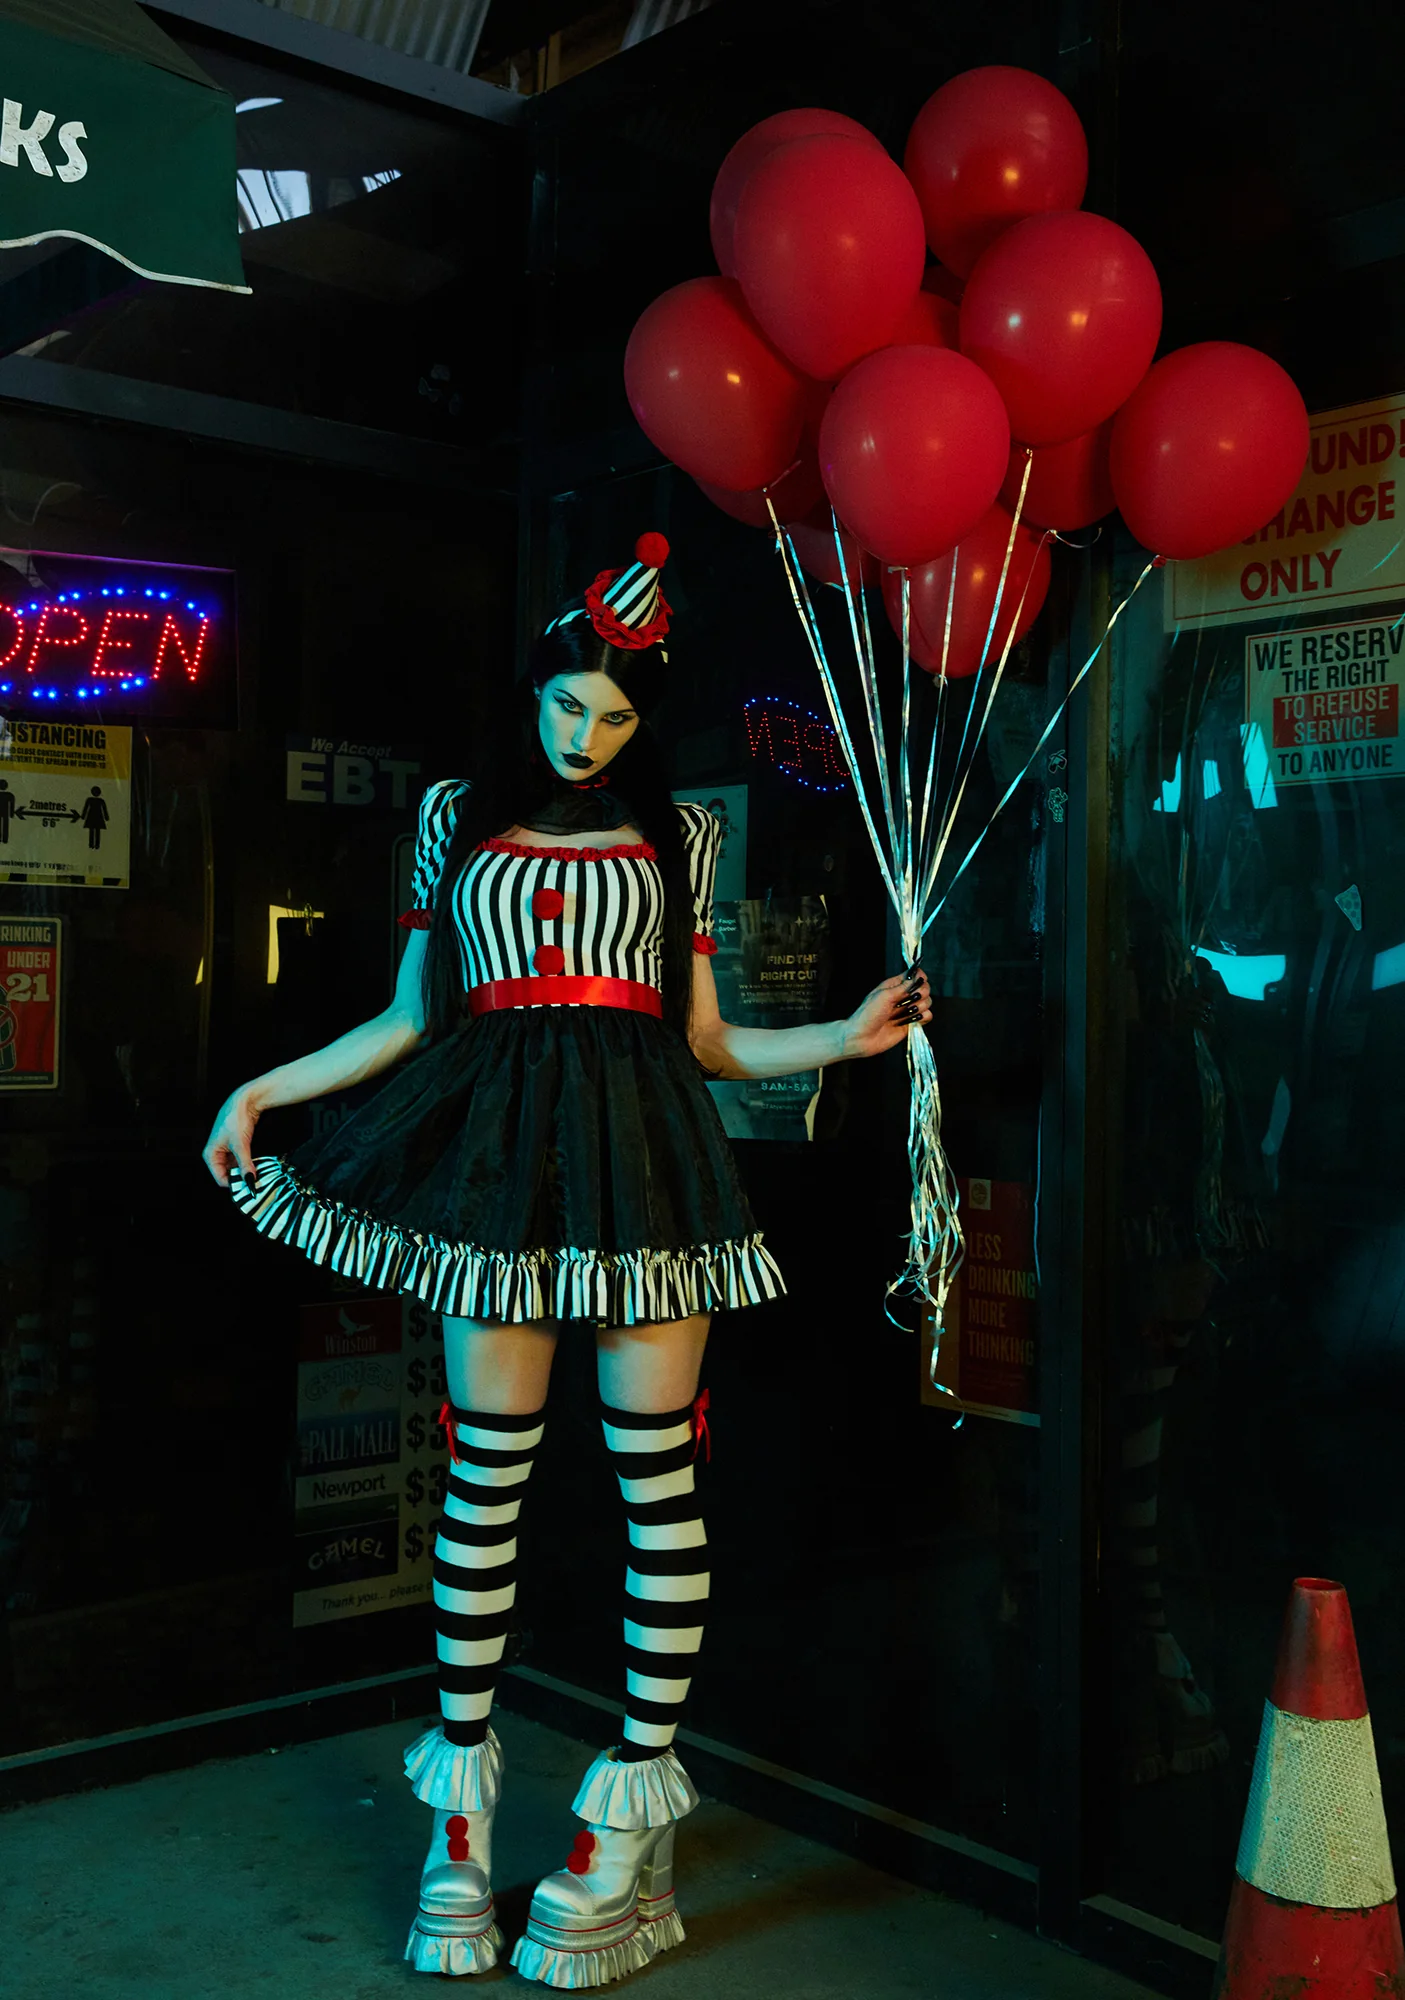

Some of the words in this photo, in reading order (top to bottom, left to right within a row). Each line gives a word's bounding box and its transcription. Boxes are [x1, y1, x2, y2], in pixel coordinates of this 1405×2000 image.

[0, 97, 89, 183] KS
[1308, 419, 1405, 475] UND!
[1240, 480, 1396, 546] HANGE
[1240, 548, 1342, 601] ONLY
[1254, 639, 1292, 671] WE
[1301, 624, 1404, 666] RESERV
[1282, 668, 1320, 693] THE
[1326, 659, 1390, 689] RIGHT
[1281, 696, 1306, 720] TO
[1312, 687, 1390, 717] REFUSE
[8, 722, 106, 749] ISTANCING
[1294, 715, 1377, 744] SERVICE
[310, 736, 334, 752] We
[336, 740, 393, 761] Accept
[1278, 752, 1302, 776] TO
[1309, 744, 1393, 773] ANYONE
[286, 750, 421, 809] EBT
[0, 925, 51, 943] RINKING
[7, 950, 51, 968] UNDER
[766, 954, 795, 965] FIND
[6, 972, 51, 1002] 21
[760, 970, 796, 981] RIGHT
[797, 970, 818, 980] CUT
[968, 1231, 1002, 1261] LESS
[968, 1264, 1037, 1299] DRINKING
[968, 1298, 1007, 1328] MORE
[324, 1333, 377, 1356] Winston
[967, 1330, 1035, 1367] THINKING
[304, 1361, 395, 1402] CAMEL
[308, 1426, 350, 1464] PALL
[353, 1420, 397, 1458] MALL
[312, 1474, 386, 1500] Newport
[307, 1536, 386, 1571] CAMEL
[322, 1596, 355, 1610] Thank
[389, 1583, 424, 1599] please
